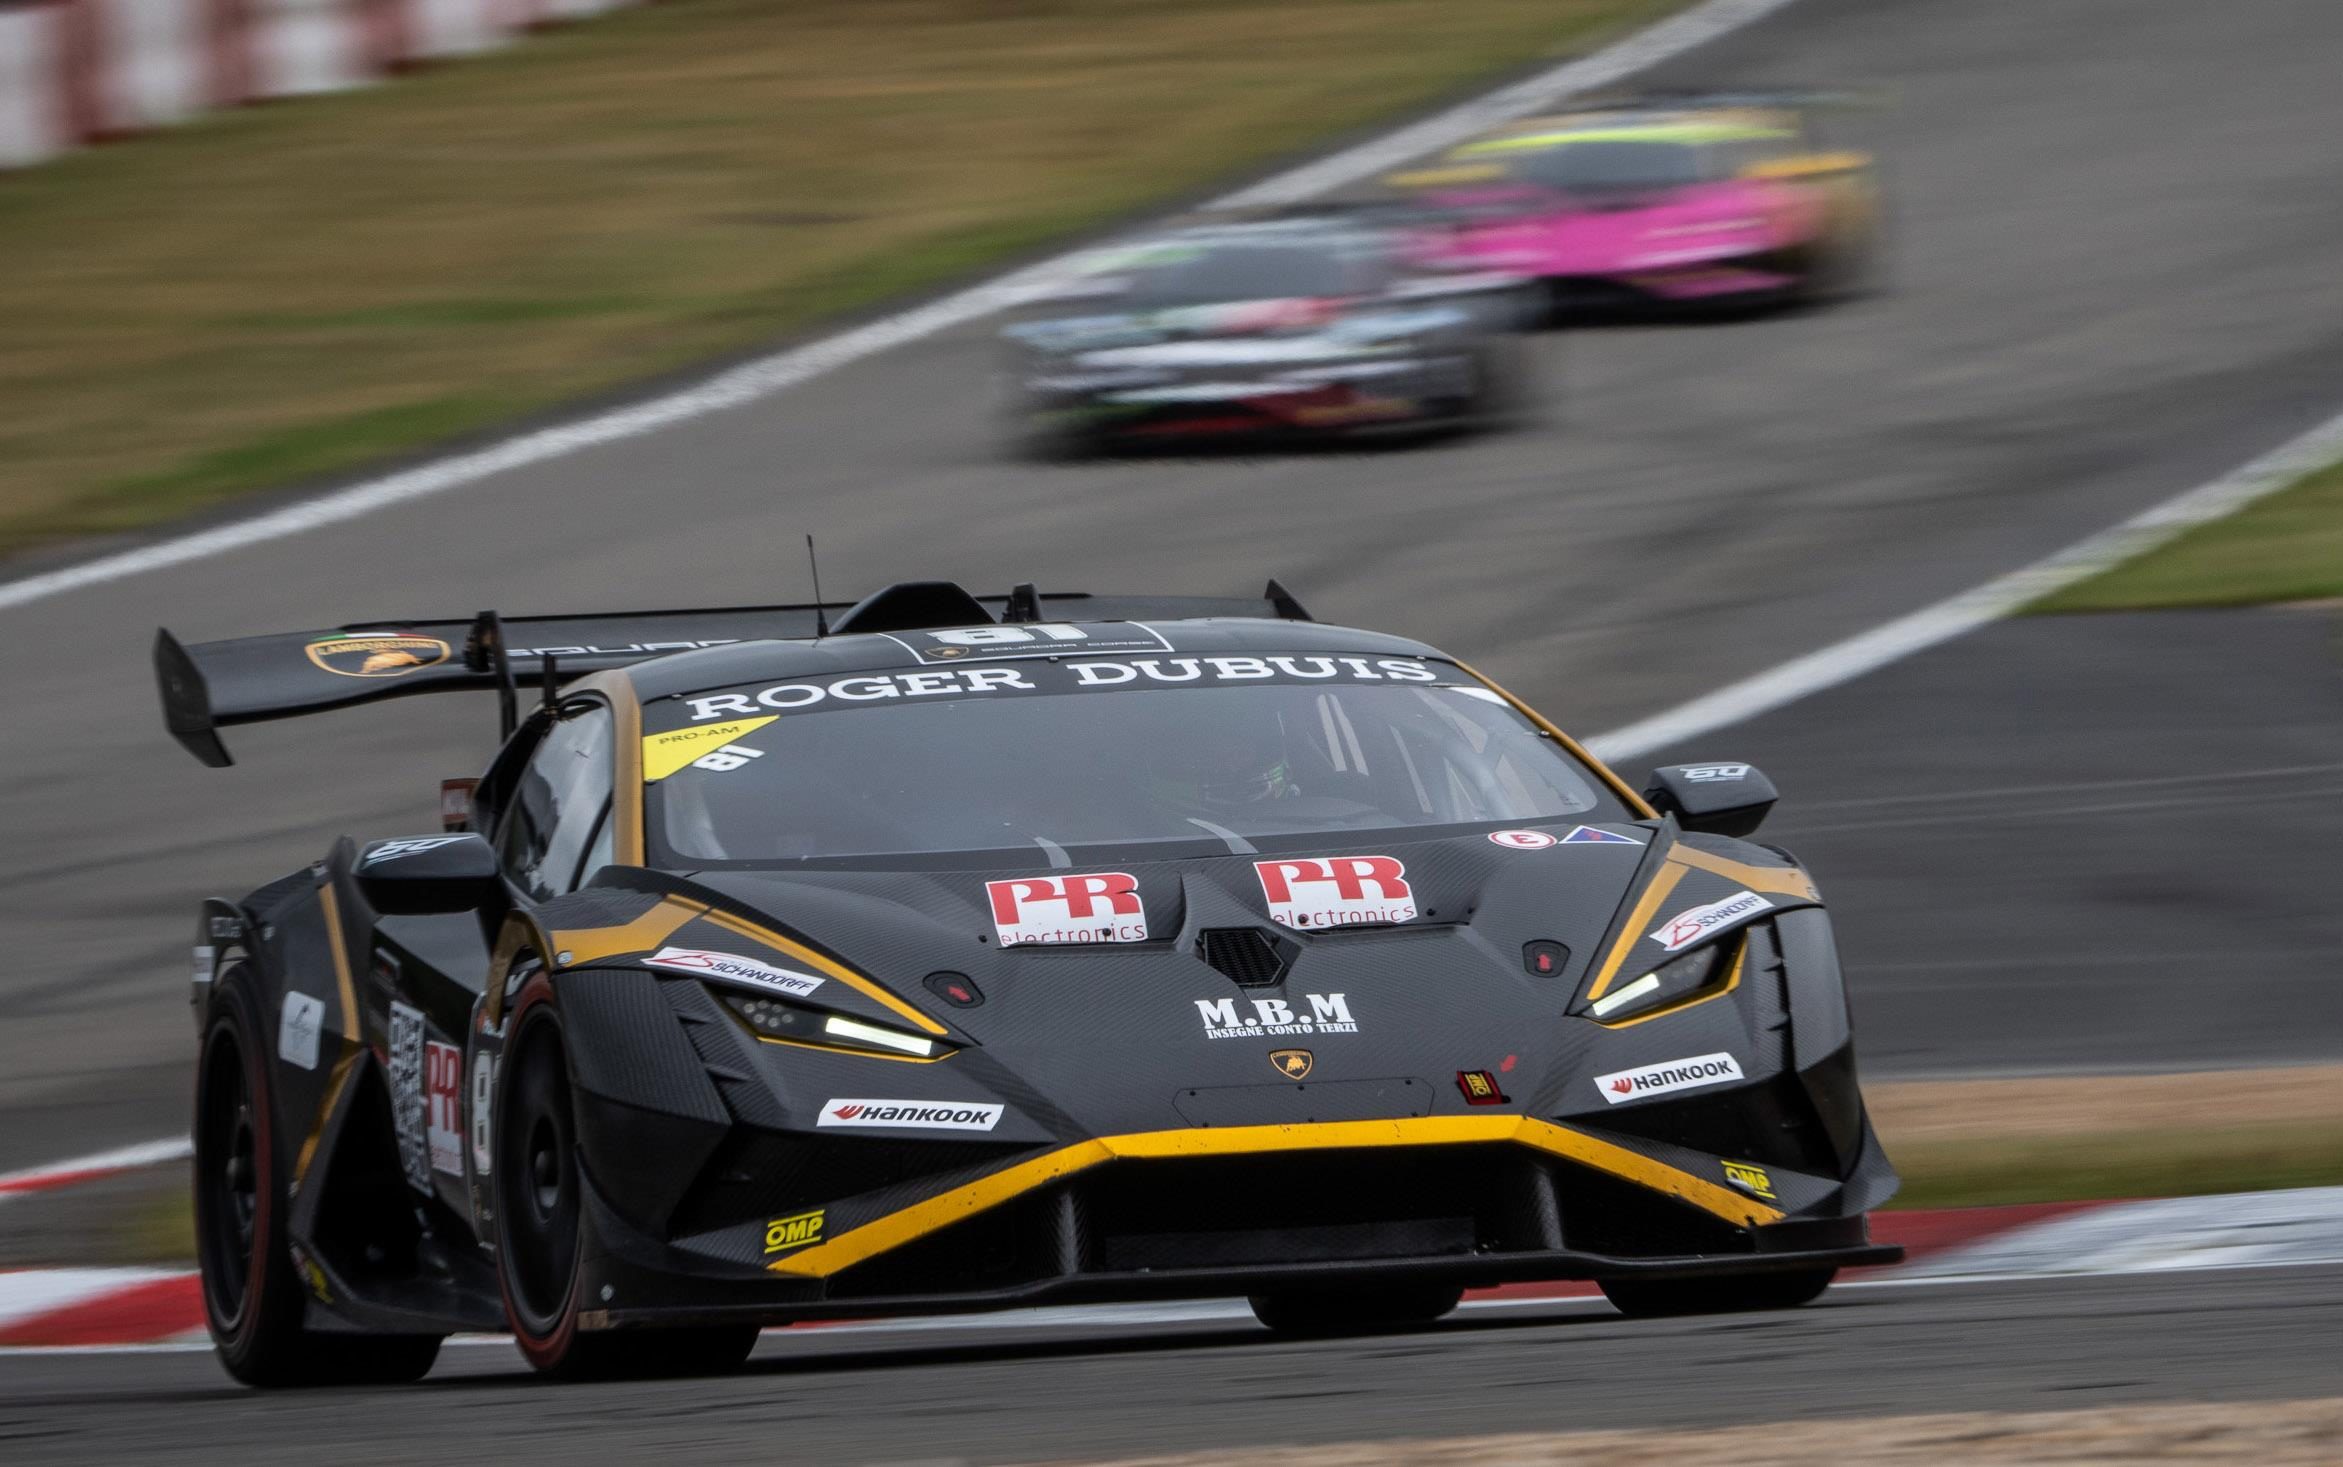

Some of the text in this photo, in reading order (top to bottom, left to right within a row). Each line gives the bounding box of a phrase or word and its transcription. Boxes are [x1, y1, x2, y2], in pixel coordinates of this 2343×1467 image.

[926, 624, 1088, 645] 81
[686, 656, 1437, 720] ROGER DUBUIS
[659, 726, 740, 745] PRO-AM
[691, 744, 765, 773] 81
[1256, 857, 1410, 904] PR
[988, 874, 1141, 925] PR
[711, 961, 815, 991] SCHANDORFF
[1194, 993, 1356, 1030] M.B.M
[1205, 1022, 1358, 1039] INSEGNE CONTO TERZI
[472, 1050, 501, 1176] 8
[1725, 1165, 1771, 1192] OMP
[765, 1215, 824, 1247] OMP
